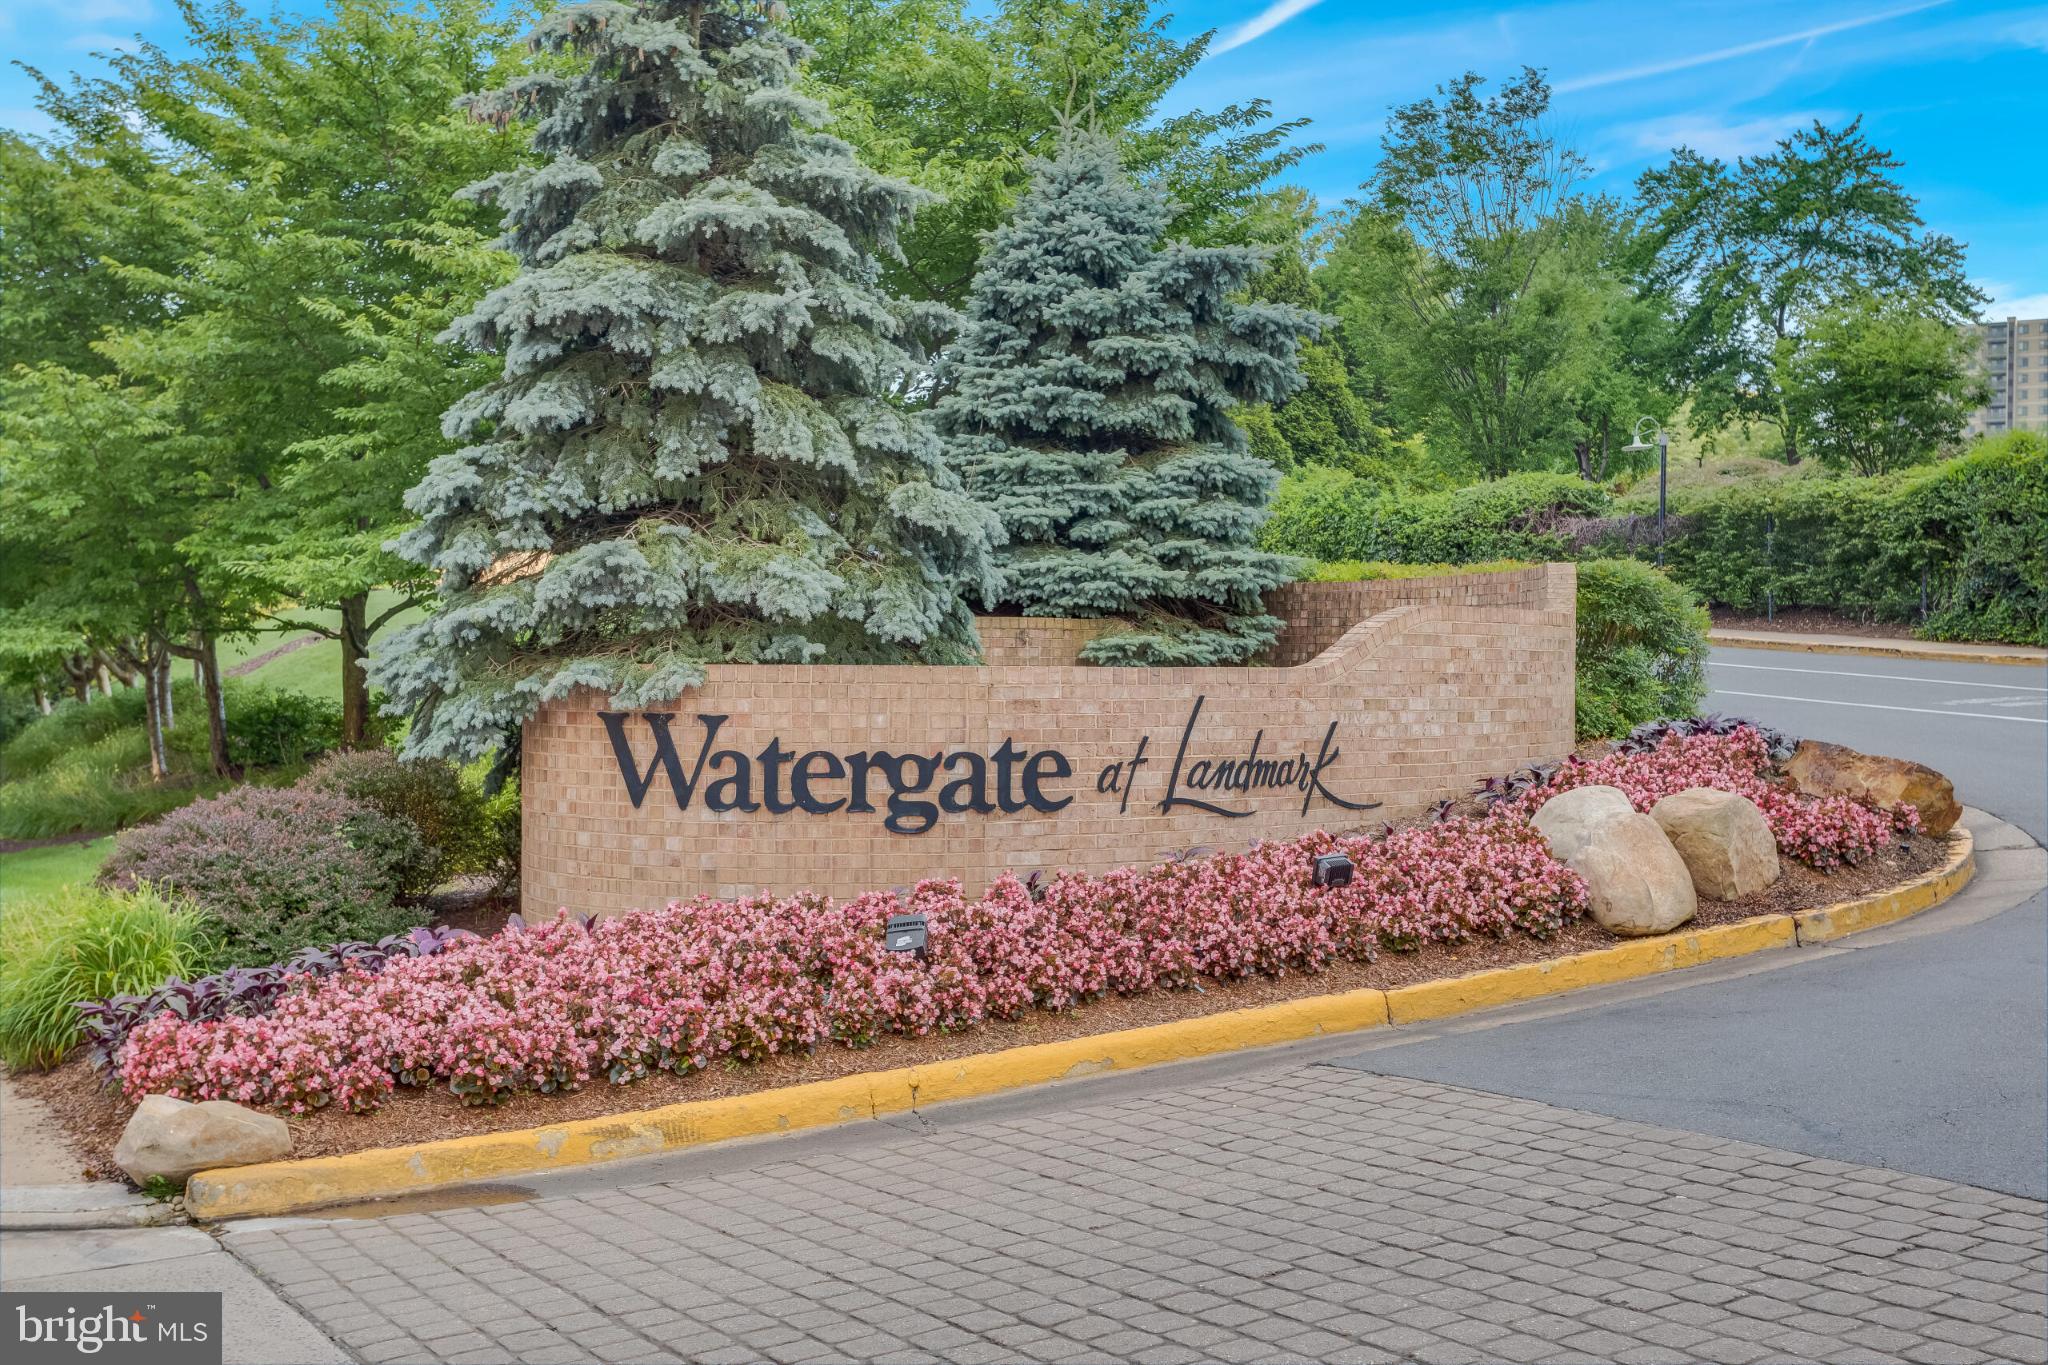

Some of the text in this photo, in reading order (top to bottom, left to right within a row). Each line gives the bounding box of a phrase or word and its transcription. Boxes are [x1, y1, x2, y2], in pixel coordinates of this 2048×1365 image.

[597, 695, 1383, 834] Watergate at Landmark
